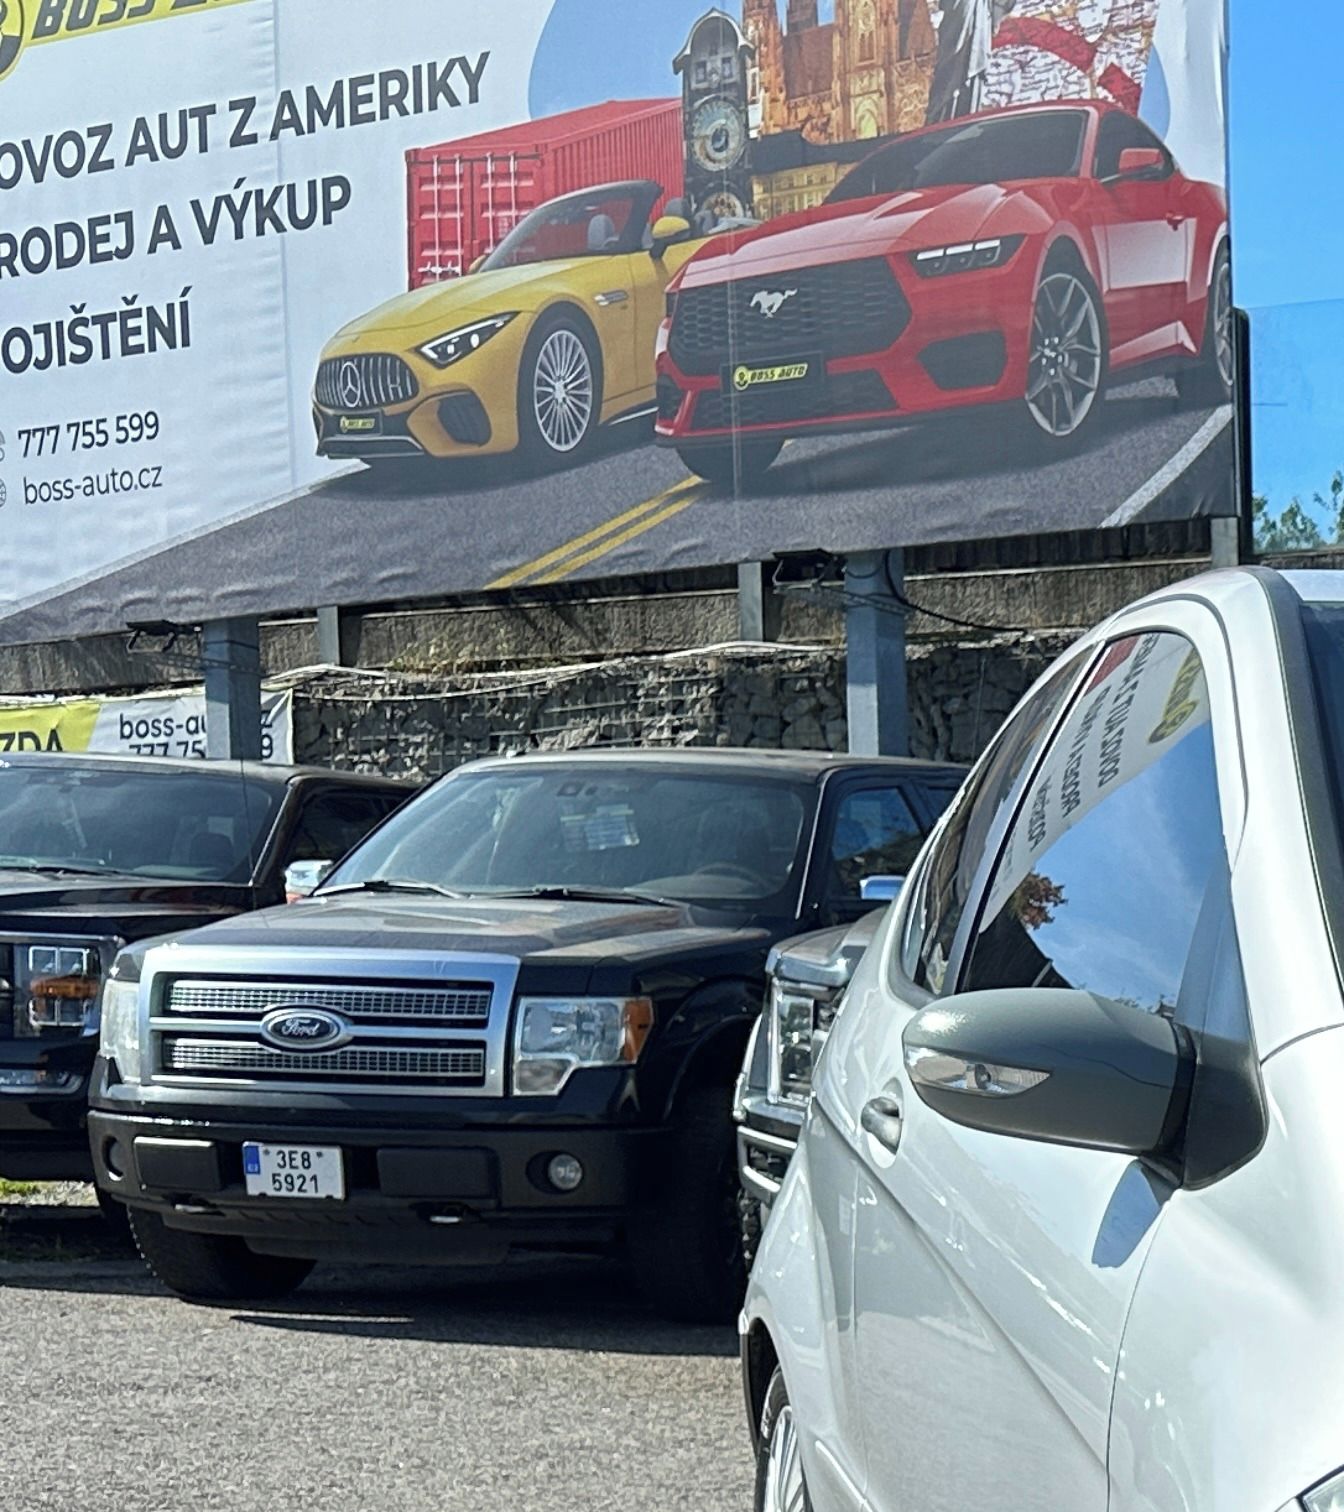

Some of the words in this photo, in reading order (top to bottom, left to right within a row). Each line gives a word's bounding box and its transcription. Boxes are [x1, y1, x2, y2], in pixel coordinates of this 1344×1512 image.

[125, 103, 217, 167] AUT
[228, 96, 258, 148] Z
[269, 51, 491, 141] AMERIKY
[147, 204, 182, 255] A
[189, 175, 352, 246] VÝKUP
[1, 285, 193, 374] OJIŠTĚNÍ
[18, 425, 60, 458] 777
[67, 418, 109, 451] 755
[115, 411, 160, 444] 599
[24, 466, 163, 504] boss-auto.cz
[281, 1017, 321, 1036] Ford
[276, 1150, 312, 1170] 3E8
[272, 1173, 319, 1193] 5921
